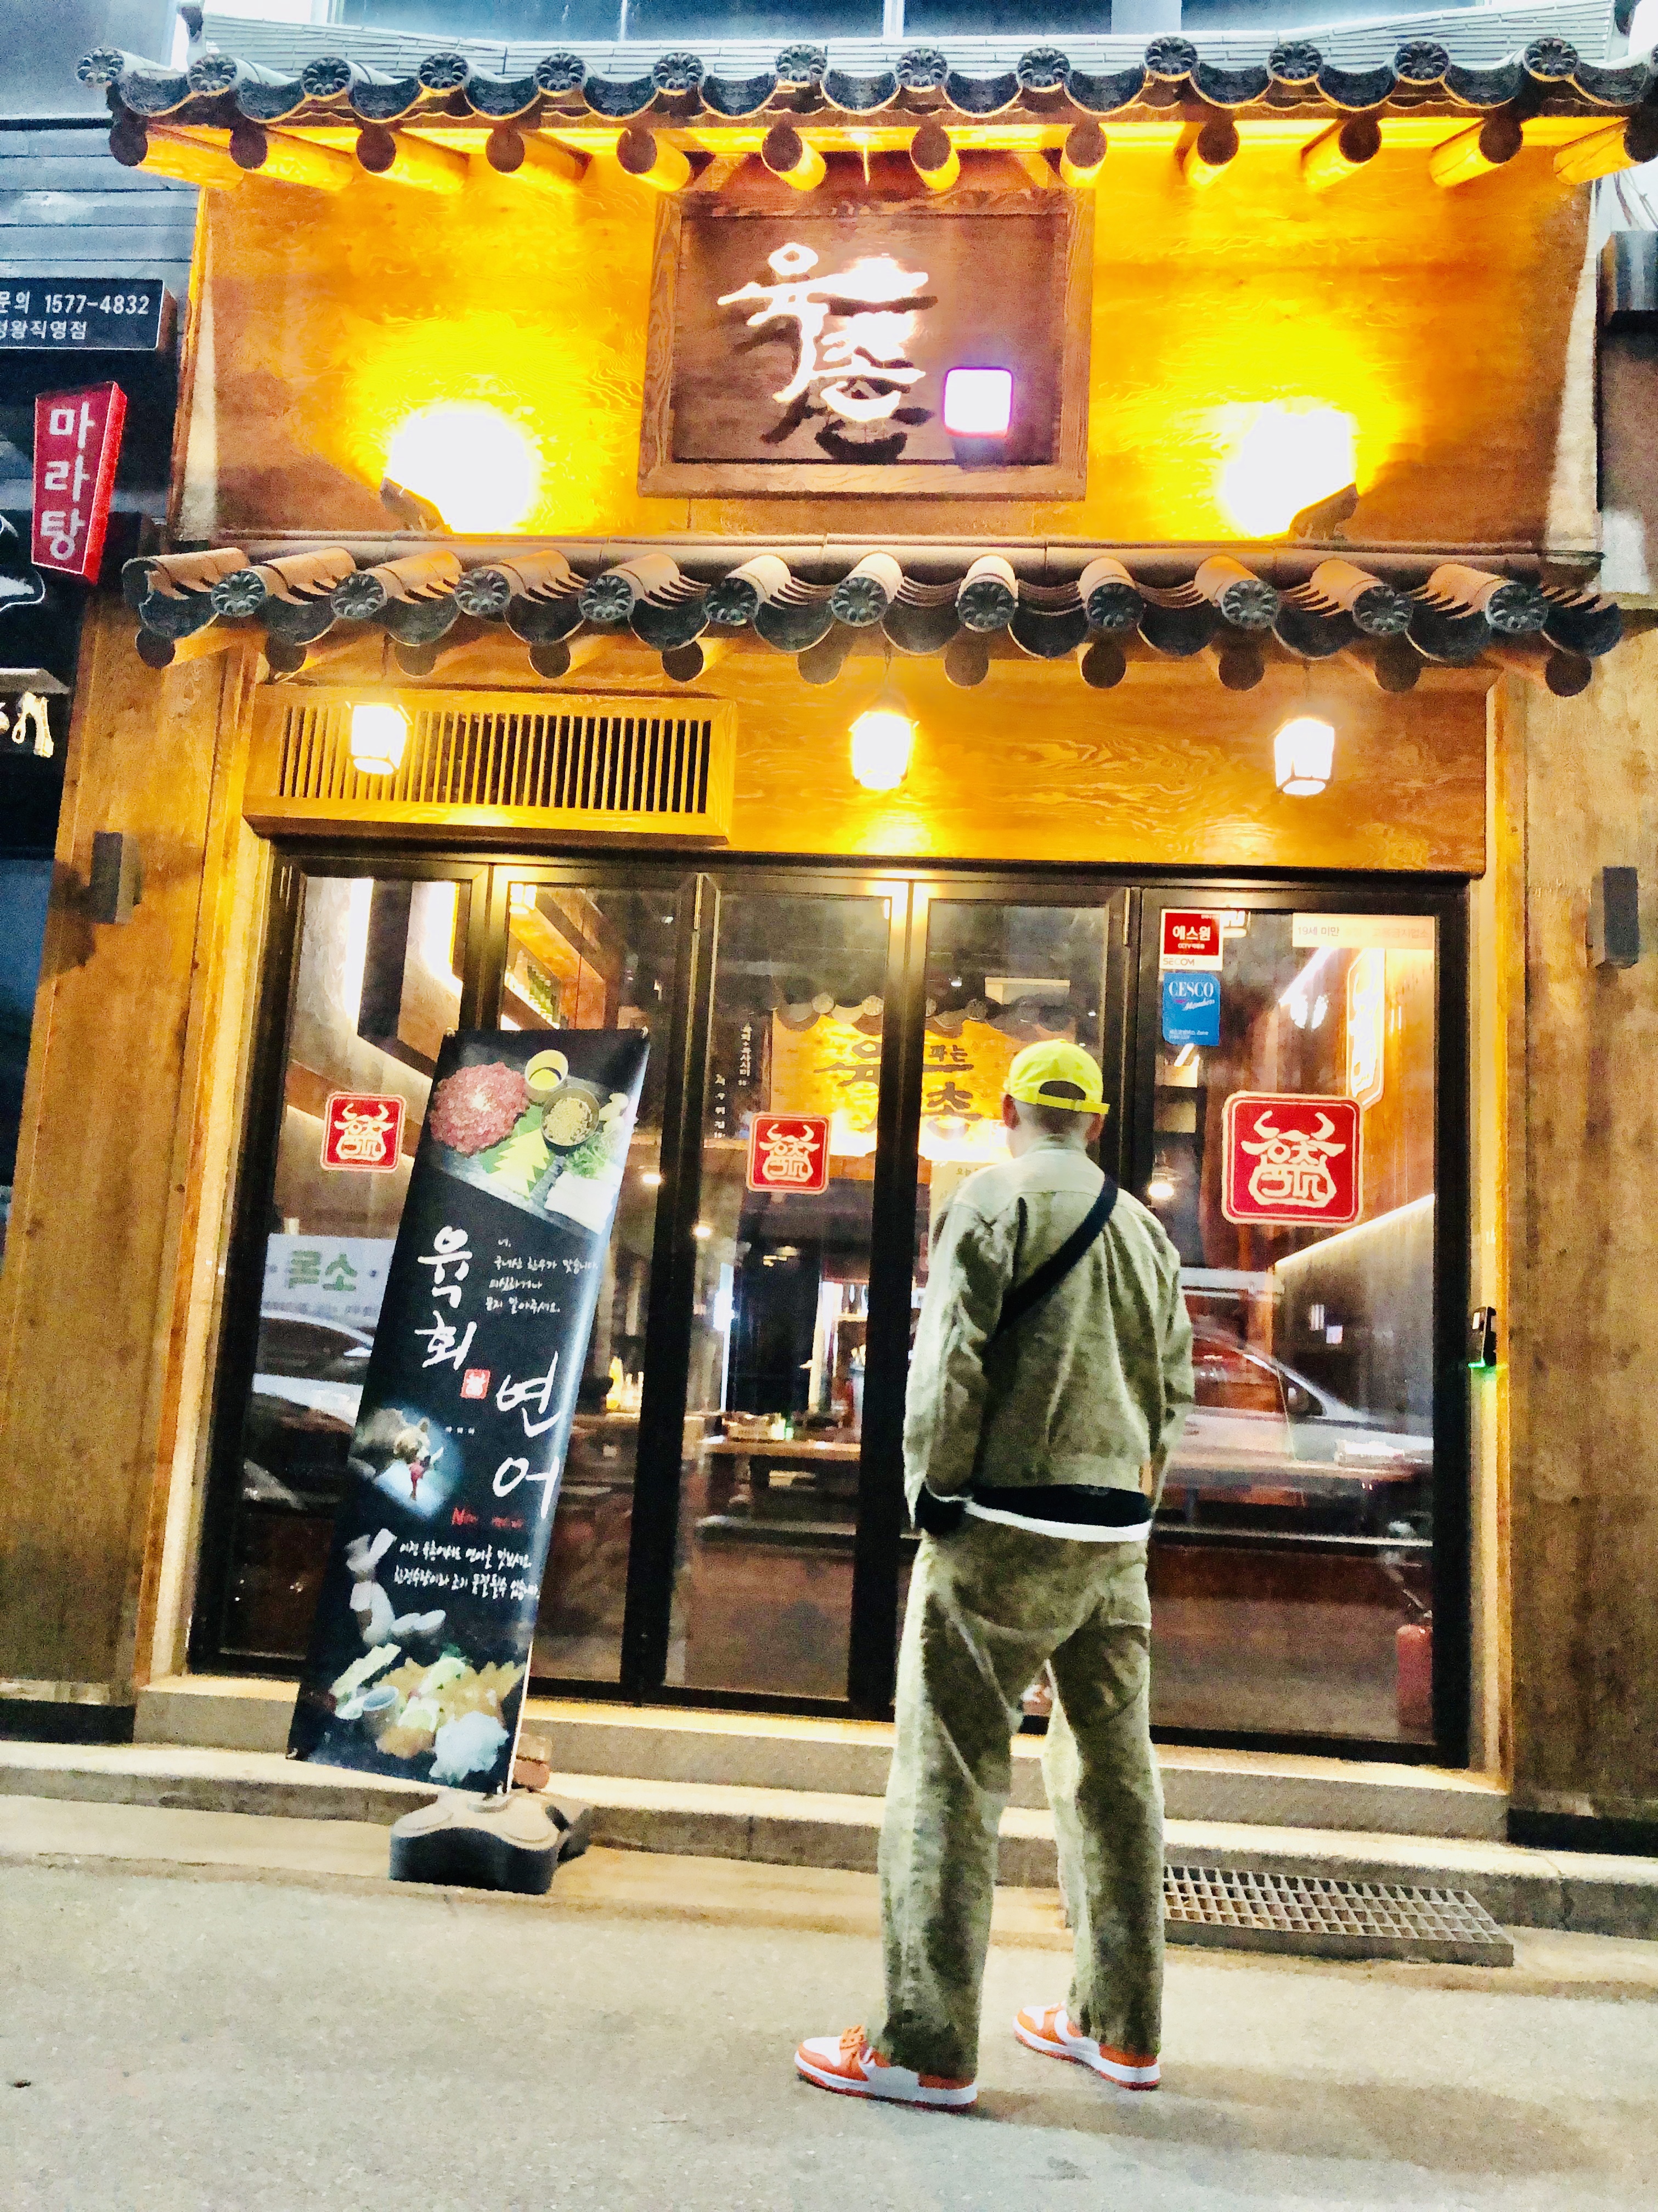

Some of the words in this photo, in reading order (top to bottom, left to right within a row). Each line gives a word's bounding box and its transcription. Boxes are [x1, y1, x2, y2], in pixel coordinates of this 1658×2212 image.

[45, 295, 150, 314] 1577-4832
[41, 402, 95, 561] 마라탕
[1172, 925, 1211, 941] 에스원
[1321, 926, 1340, 937] 미만
[1163, 958, 1195, 966] SECOM
[1169, 981, 1214, 997] CESCO
[929, 1045, 968, 1062] 파는
[414, 1224, 477, 1370] 육회
[493, 1351, 562, 1520] 연어
